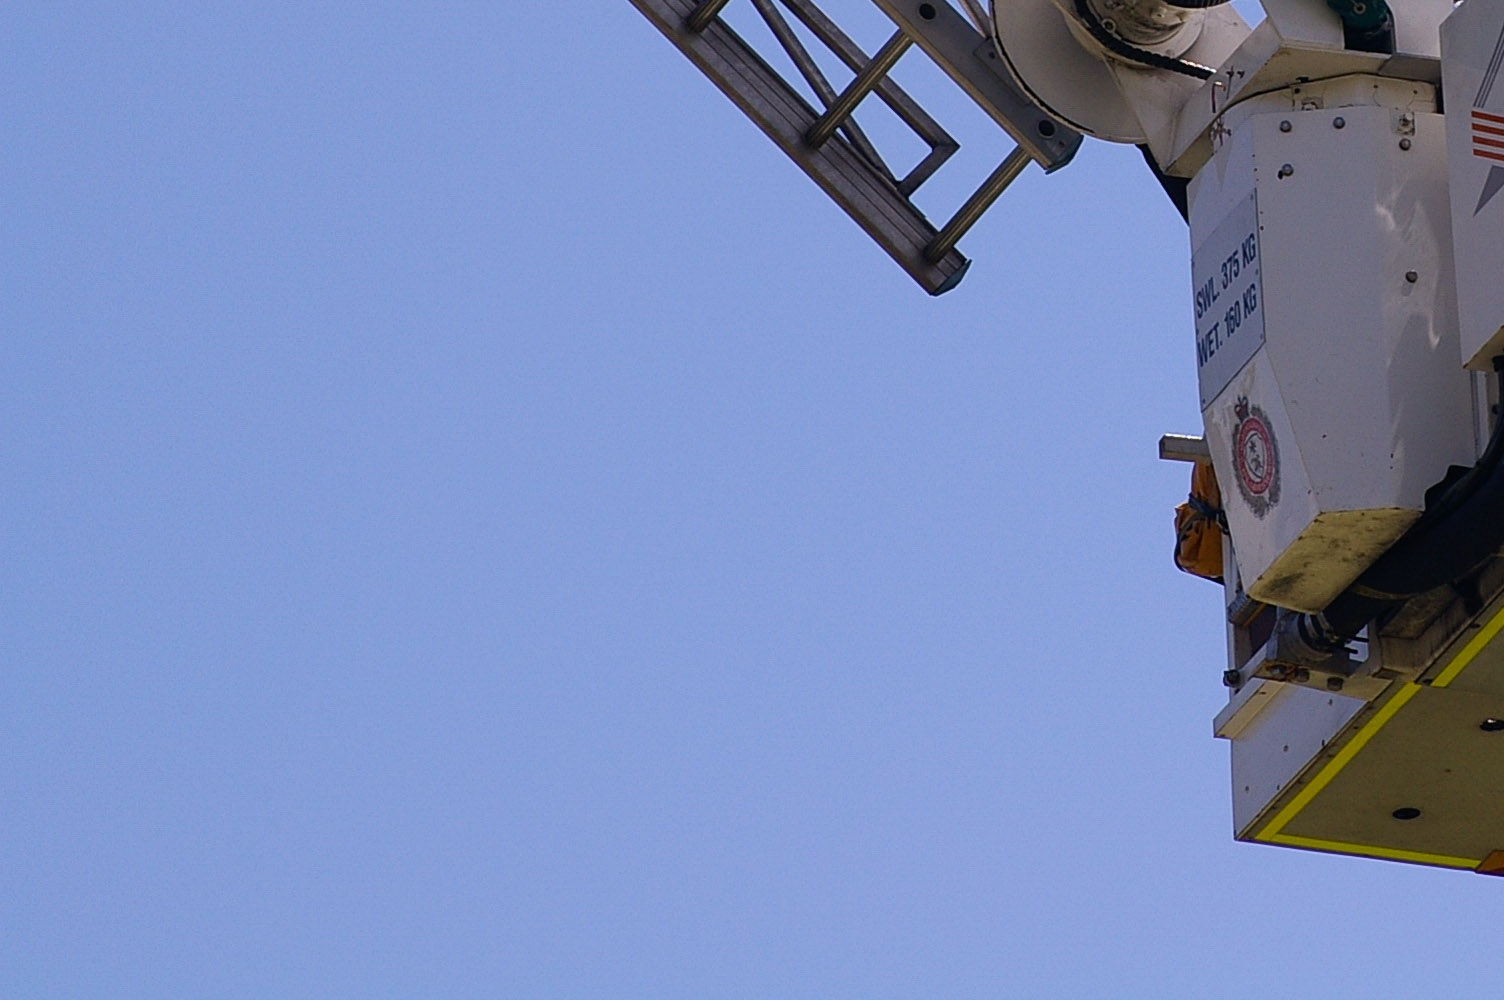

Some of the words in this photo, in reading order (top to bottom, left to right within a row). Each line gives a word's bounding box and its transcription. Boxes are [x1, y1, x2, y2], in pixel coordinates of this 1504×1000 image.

[1221, 250, 1240, 290] 375
[1242, 233, 1256, 269] KG
[1197, 322, 1223, 367] WET.
[1224, 300, 1242, 338] 160
[1242, 283, 1258, 319] KG
